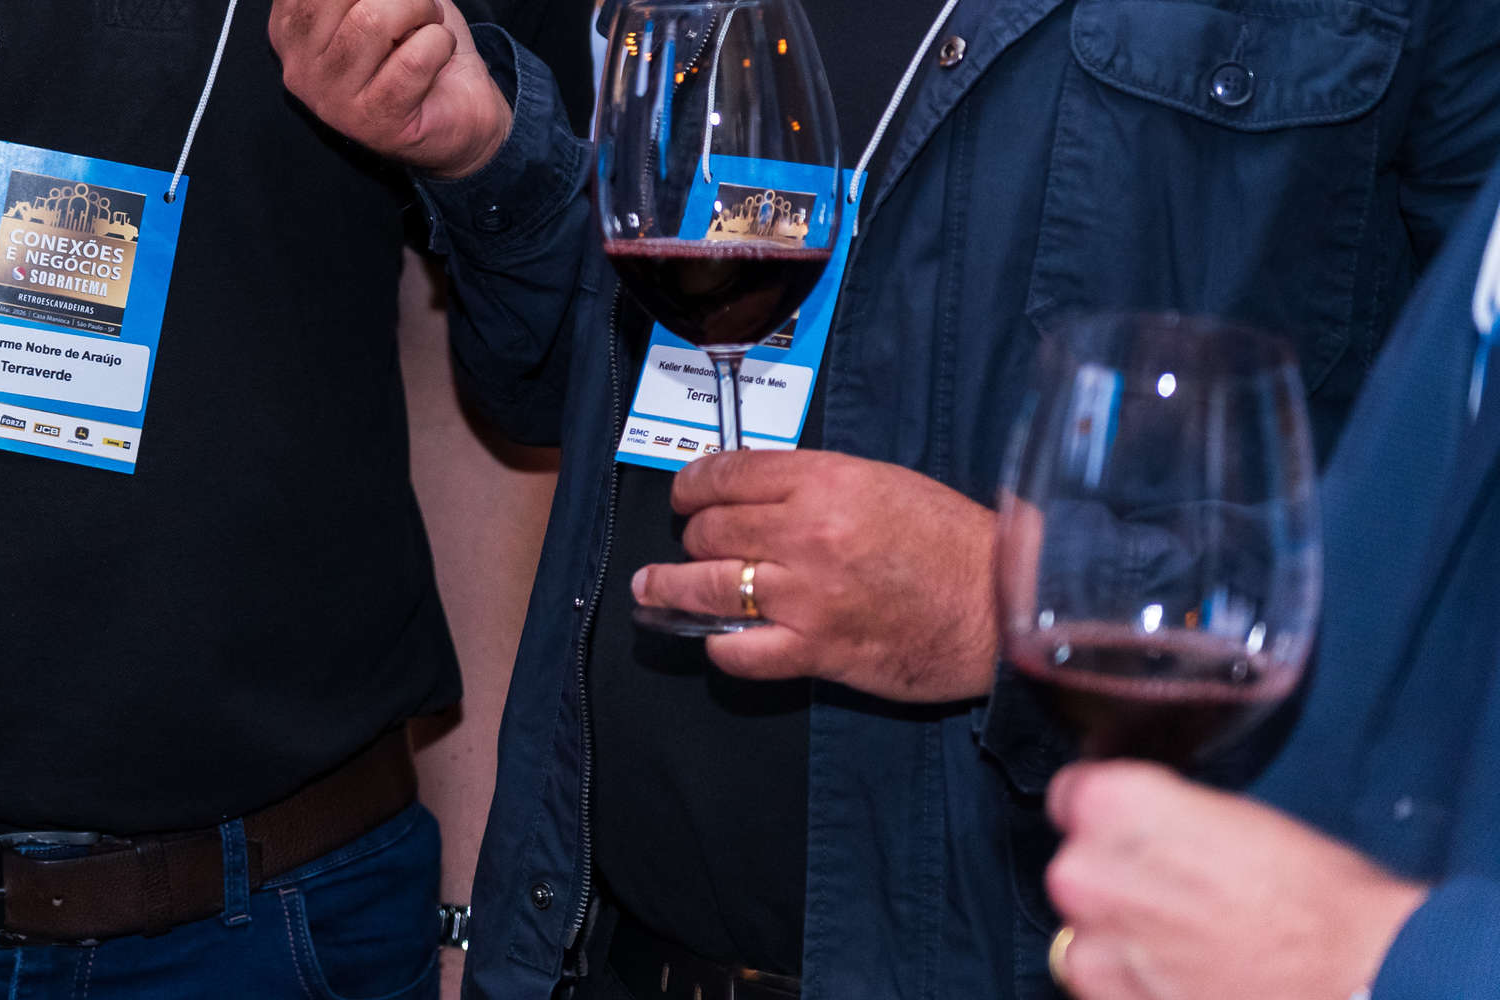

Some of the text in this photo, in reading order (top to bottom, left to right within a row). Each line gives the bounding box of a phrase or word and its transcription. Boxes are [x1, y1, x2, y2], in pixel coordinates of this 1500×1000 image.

[10, 228, 125, 264] CONEXÕES
[6, 246, 123, 281] E NEGÓCIOS
[29, 268, 108, 297] SOBRATEMA
[18, 293, 95, 315] RETROESCAVADEIRAS
[25, 341, 62, 357] Nobre
[64, 348, 80, 360] de
[81, 350, 122, 367] Araújo
[0, 360, 72, 382] Terraverde
[682, 363, 718, 379] Mendonç
[755, 375, 766, 386] de
[1, 417, 25, 428] FORZA
[35, 425, 59, 436] JCB
[629, 427, 650, 437] BMC
